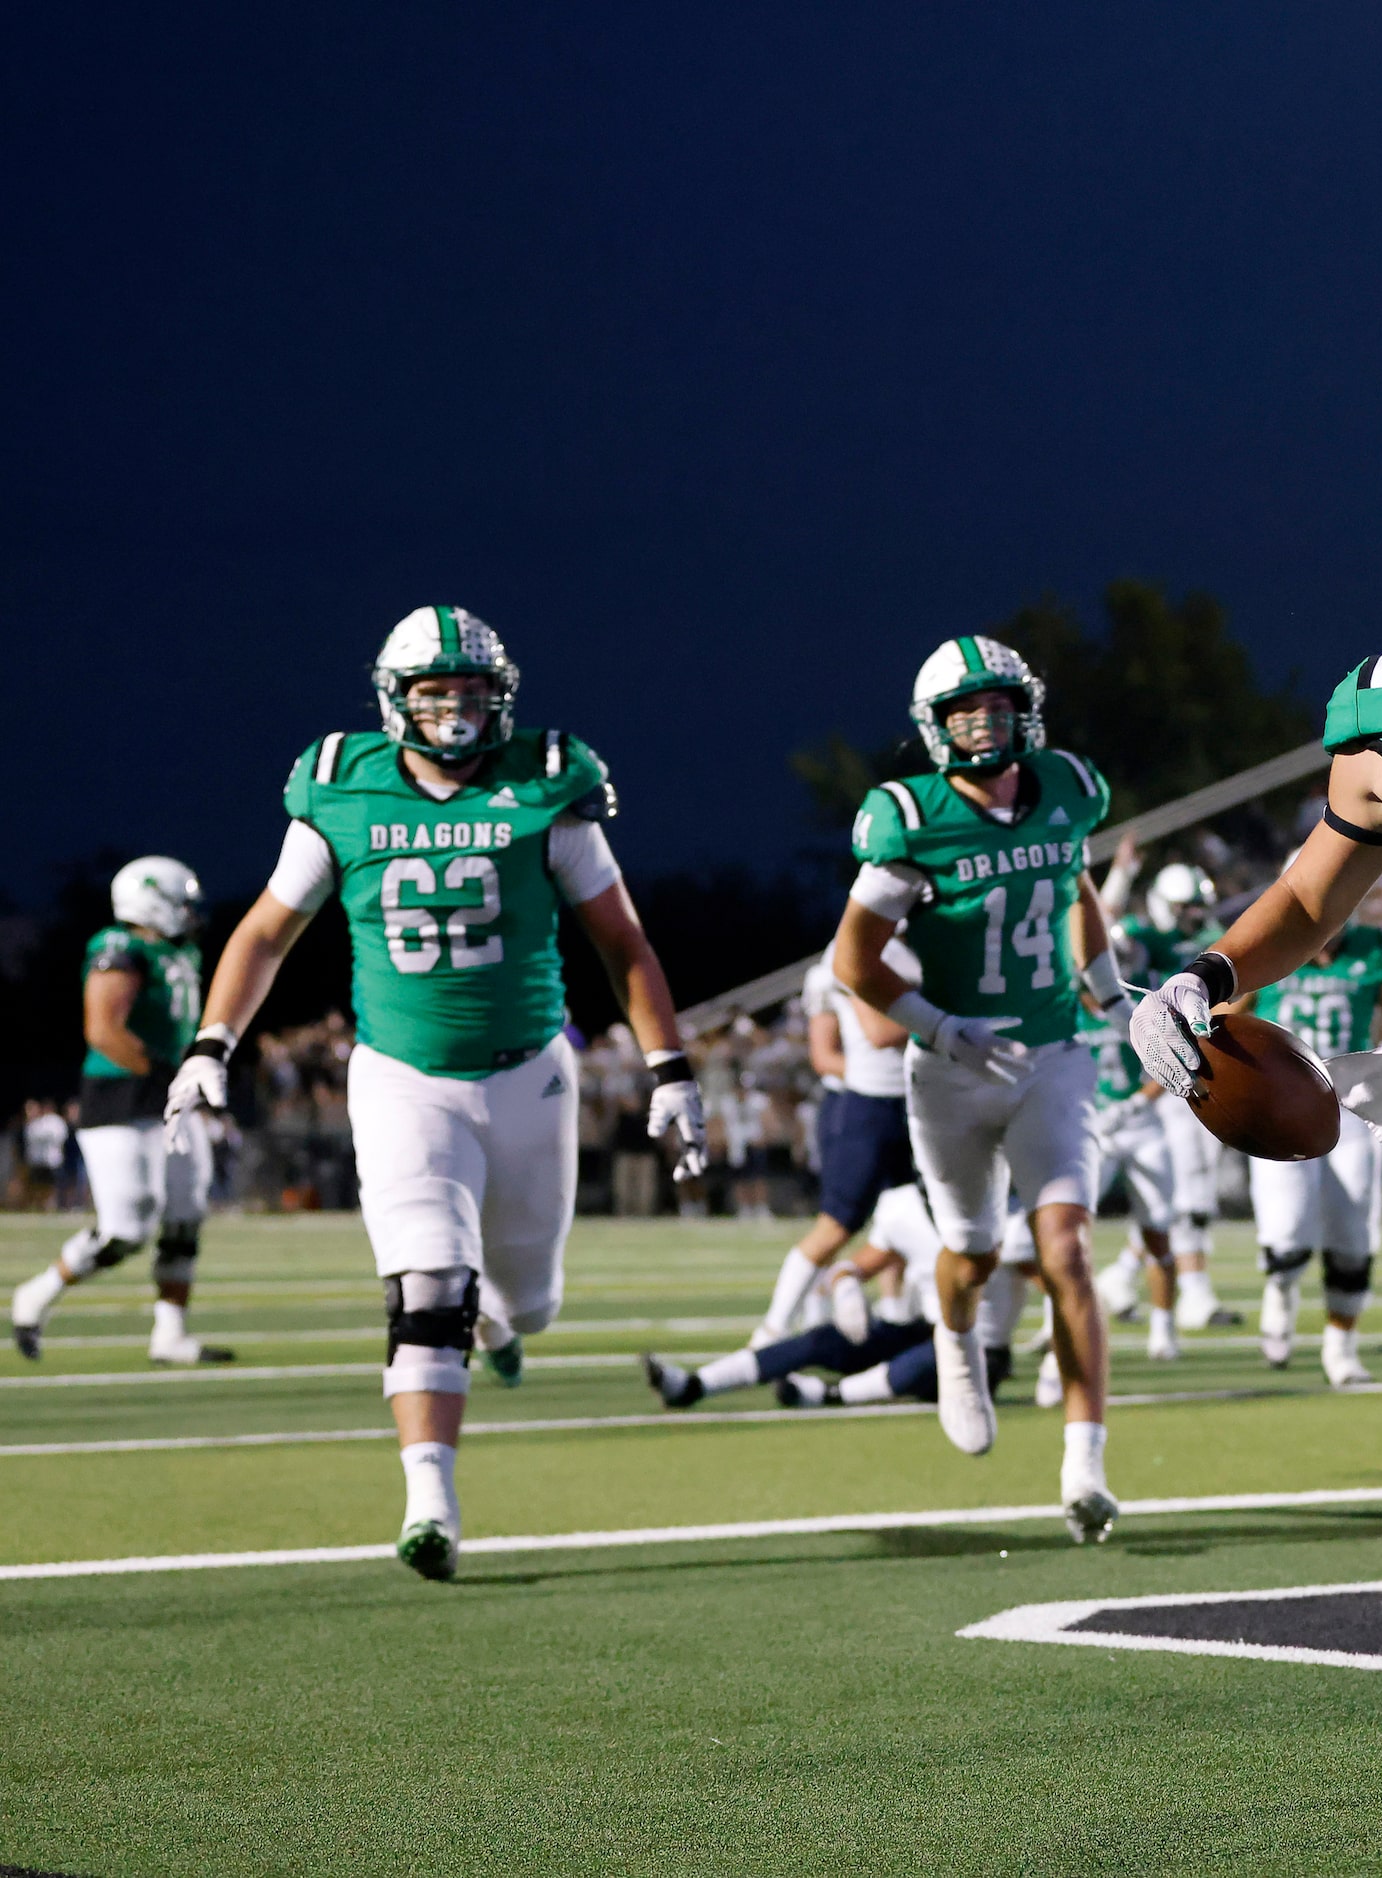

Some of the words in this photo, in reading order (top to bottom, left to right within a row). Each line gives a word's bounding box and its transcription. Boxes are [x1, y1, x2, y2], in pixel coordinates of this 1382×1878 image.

[370, 822, 513, 851] DRAGONS
[956, 842, 1075, 882] DRAGONS
[380, 856, 505, 974] 62
[977, 878, 1055, 994] 14
